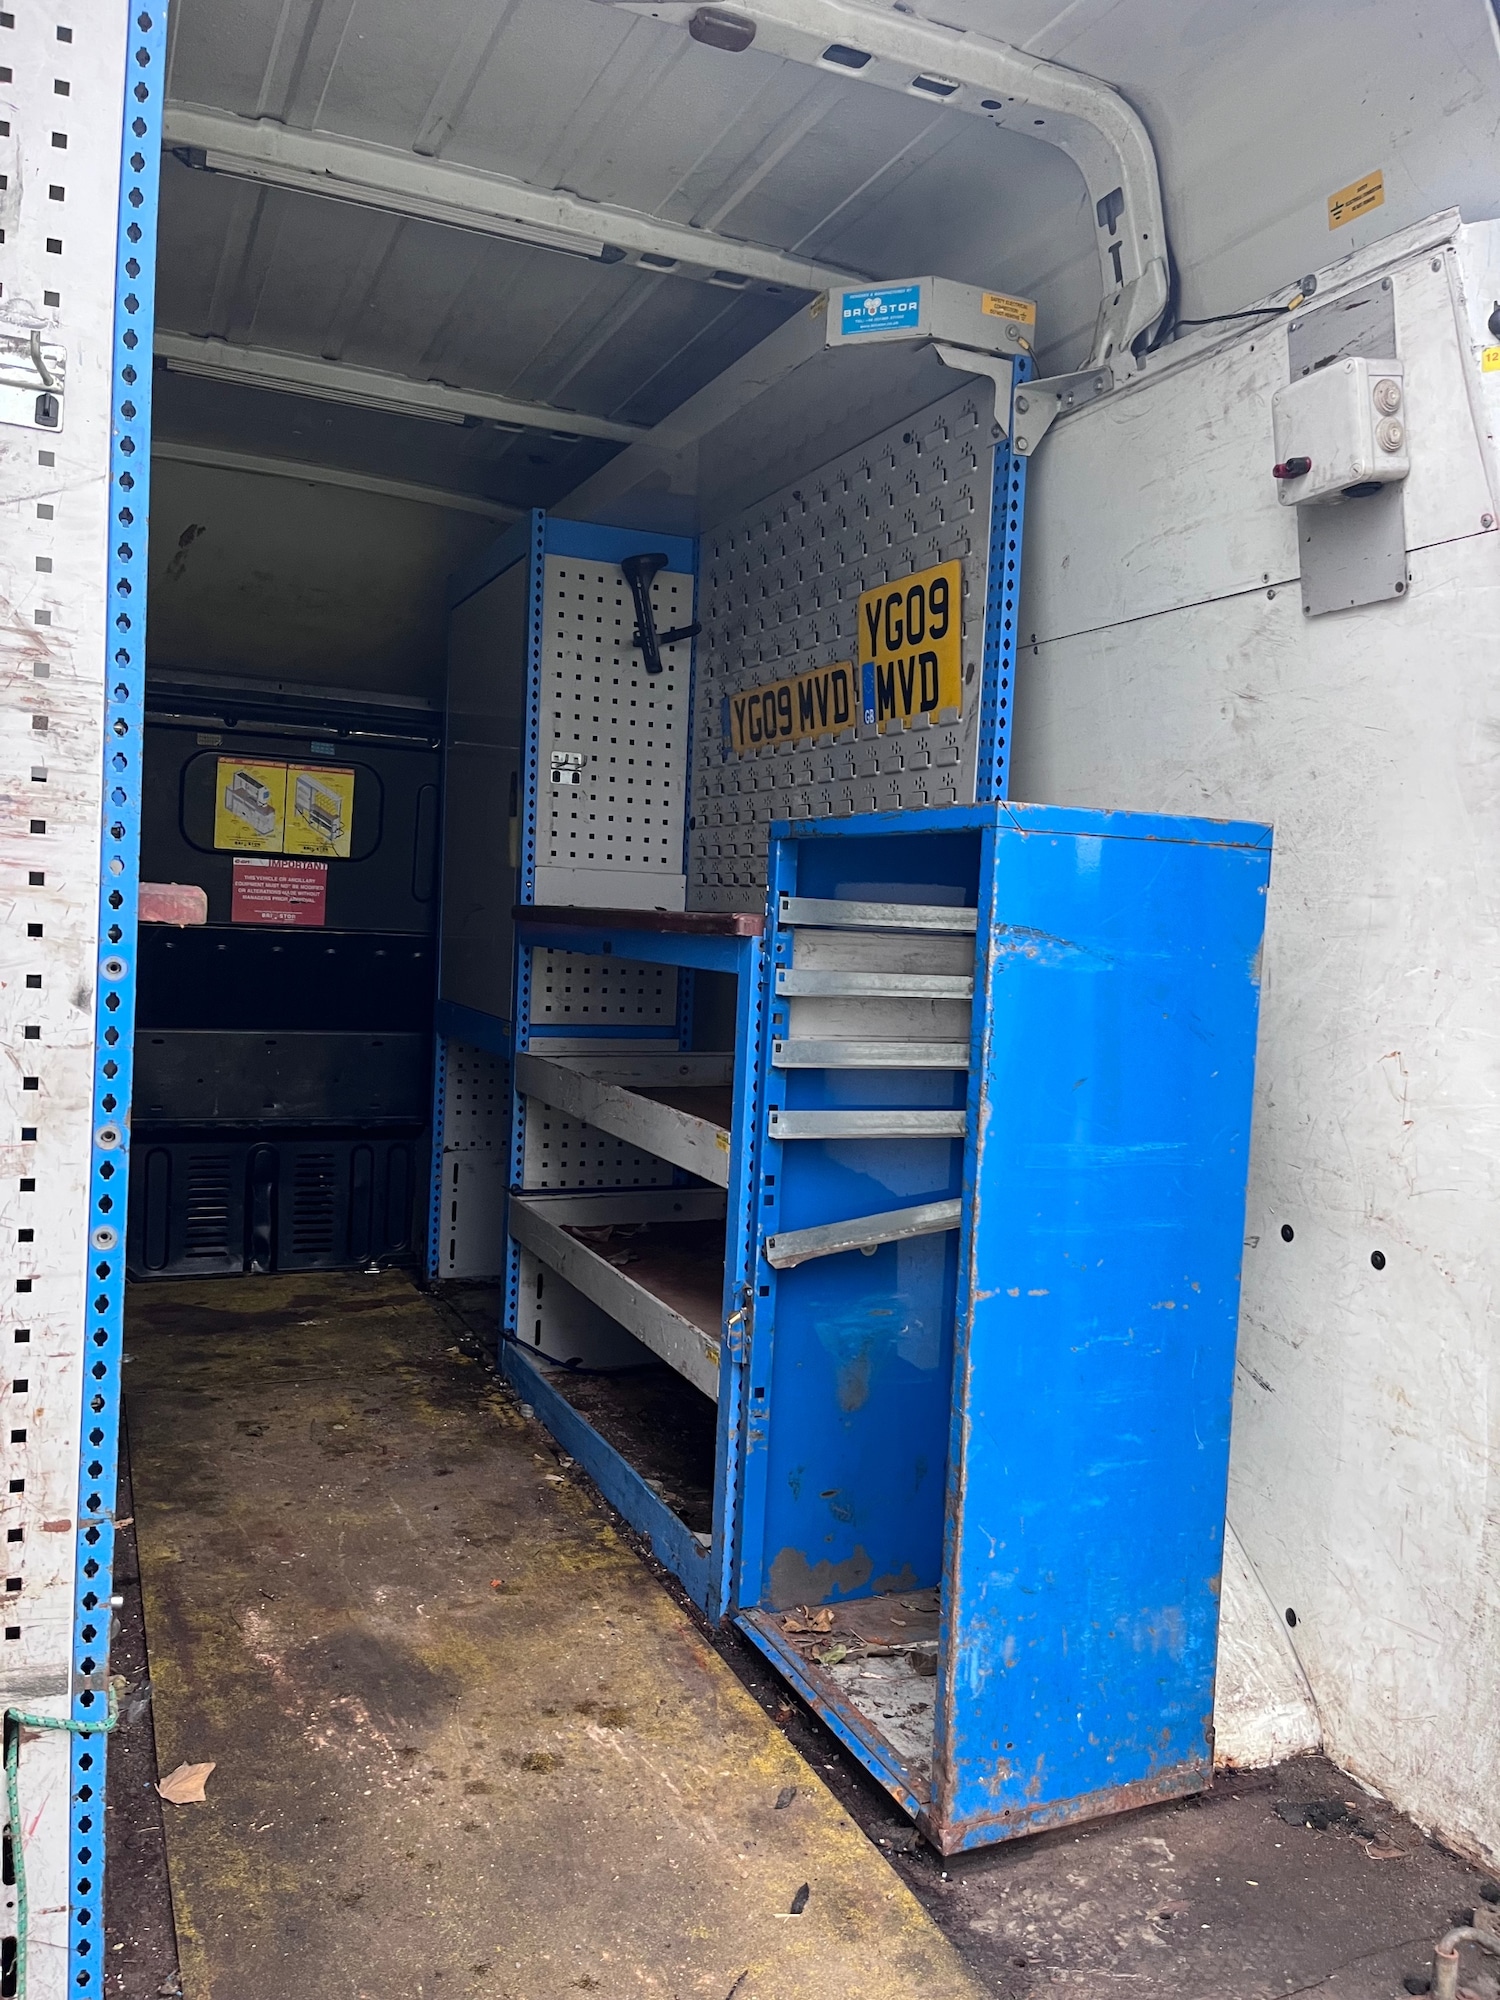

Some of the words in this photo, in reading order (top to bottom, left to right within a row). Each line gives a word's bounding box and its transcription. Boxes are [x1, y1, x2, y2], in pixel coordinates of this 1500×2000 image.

[866, 577, 948, 657] YG09
[734, 686, 792, 745] YG09
[798, 669, 849, 732] MVD
[864, 709, 875, 725] GB
[877, 651, 939, 720] MVD
[270, 859, 328, 871] IMPORTANT
